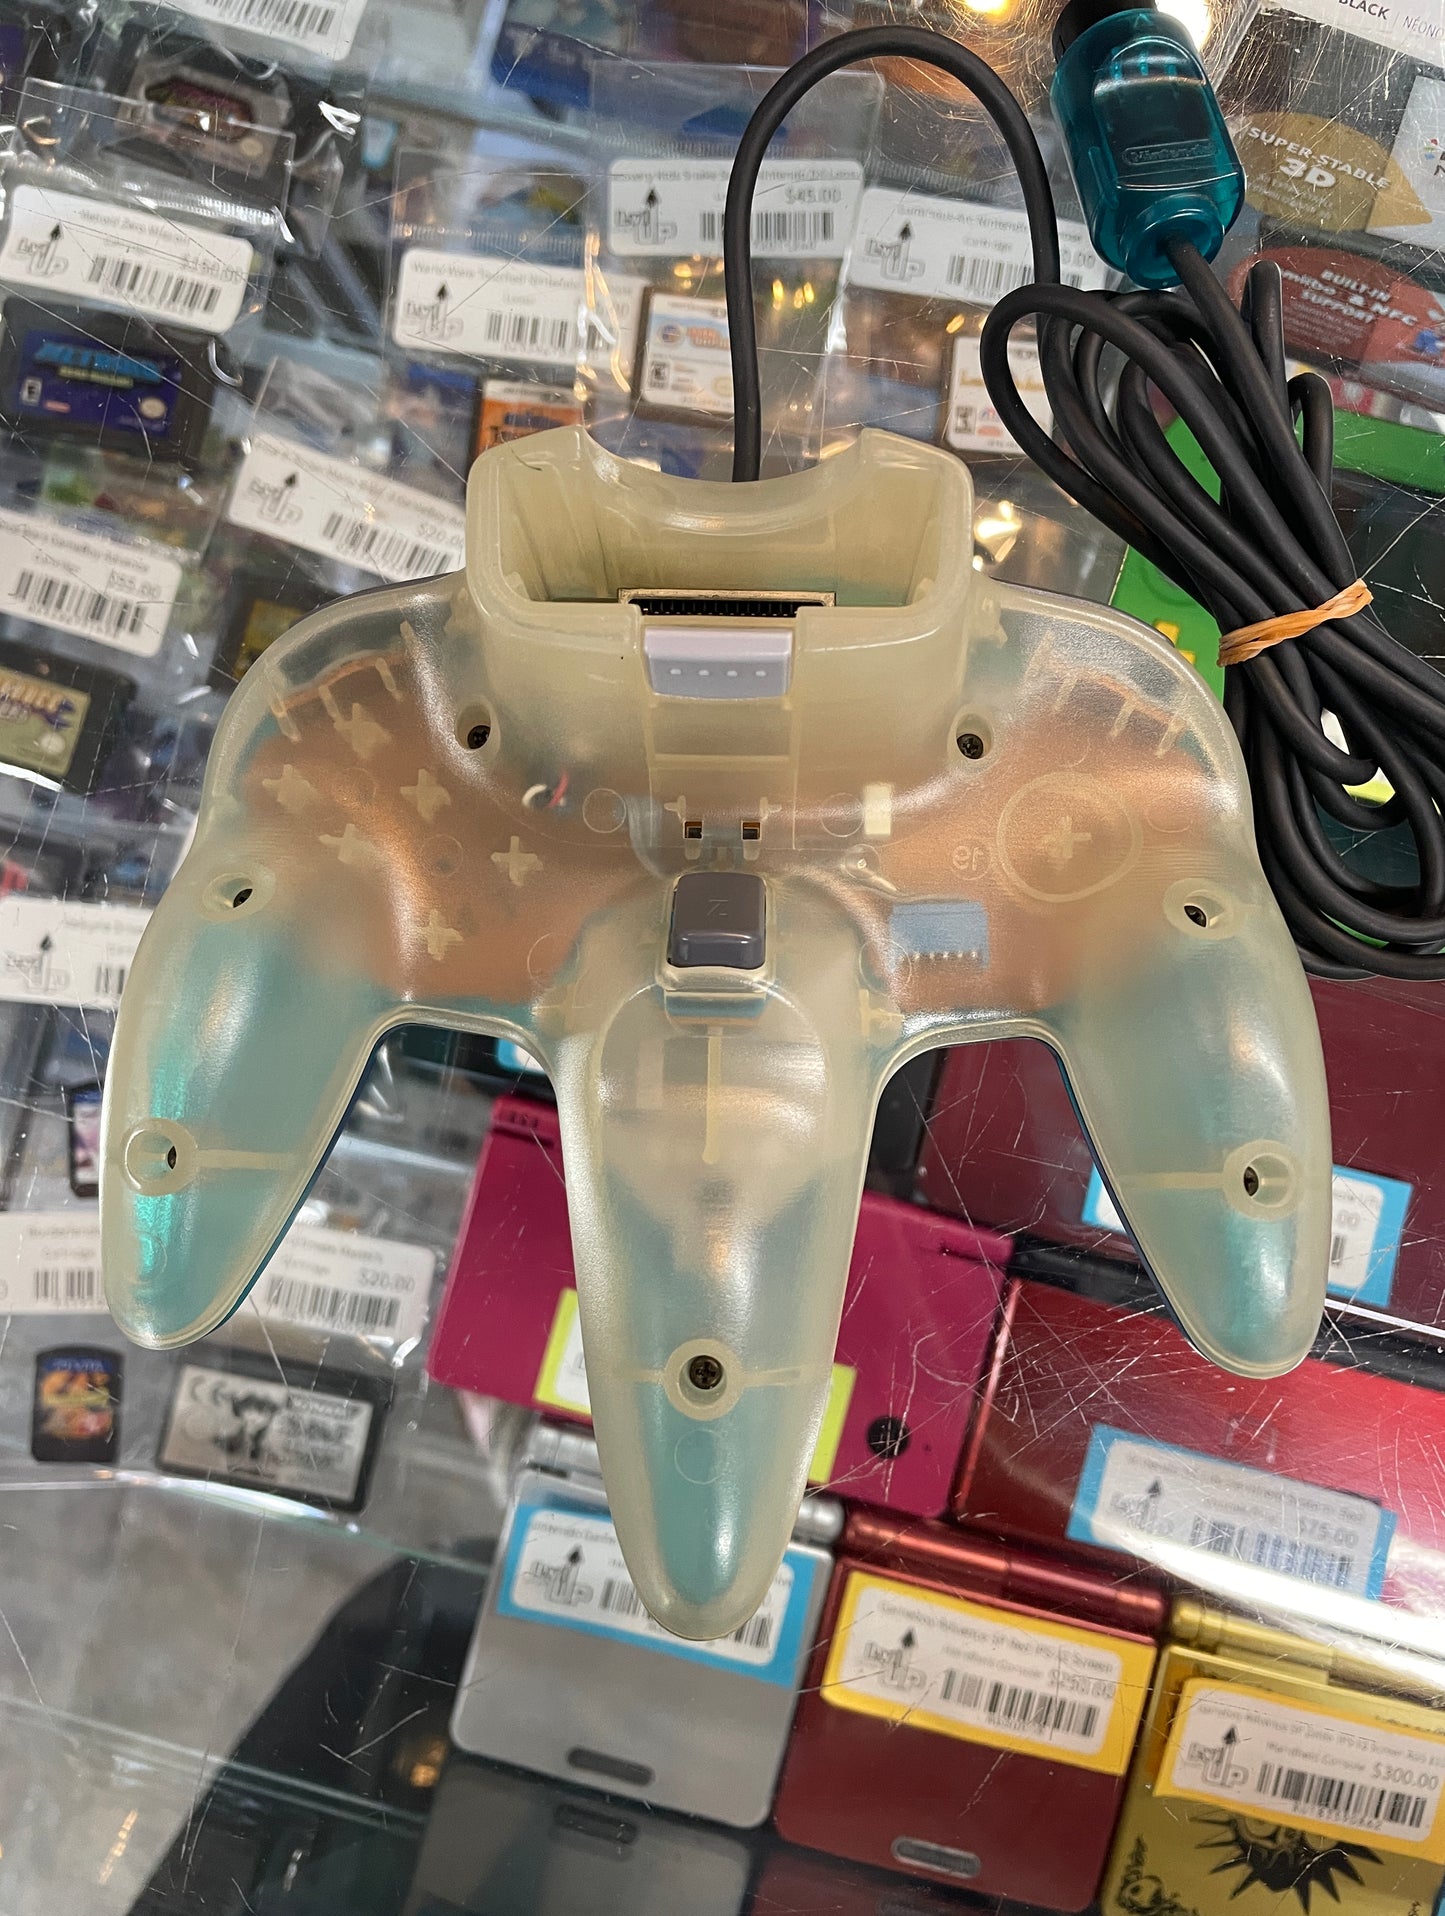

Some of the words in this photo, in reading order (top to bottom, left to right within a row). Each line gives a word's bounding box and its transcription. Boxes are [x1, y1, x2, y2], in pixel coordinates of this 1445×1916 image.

[1248, 127, 1392, 190] SUPER-STABLE
[1279, 157, 1337, 188] 3D
[785, 186, 842, 204] $45.00
[1320, 268, 1392, 302] BUILT-IN
[1301, 289, 1376, 324] SUPPORT
[1370, 302, 1418, 327] NFC
[1371, 1762, 1441, 1792] $300.00
